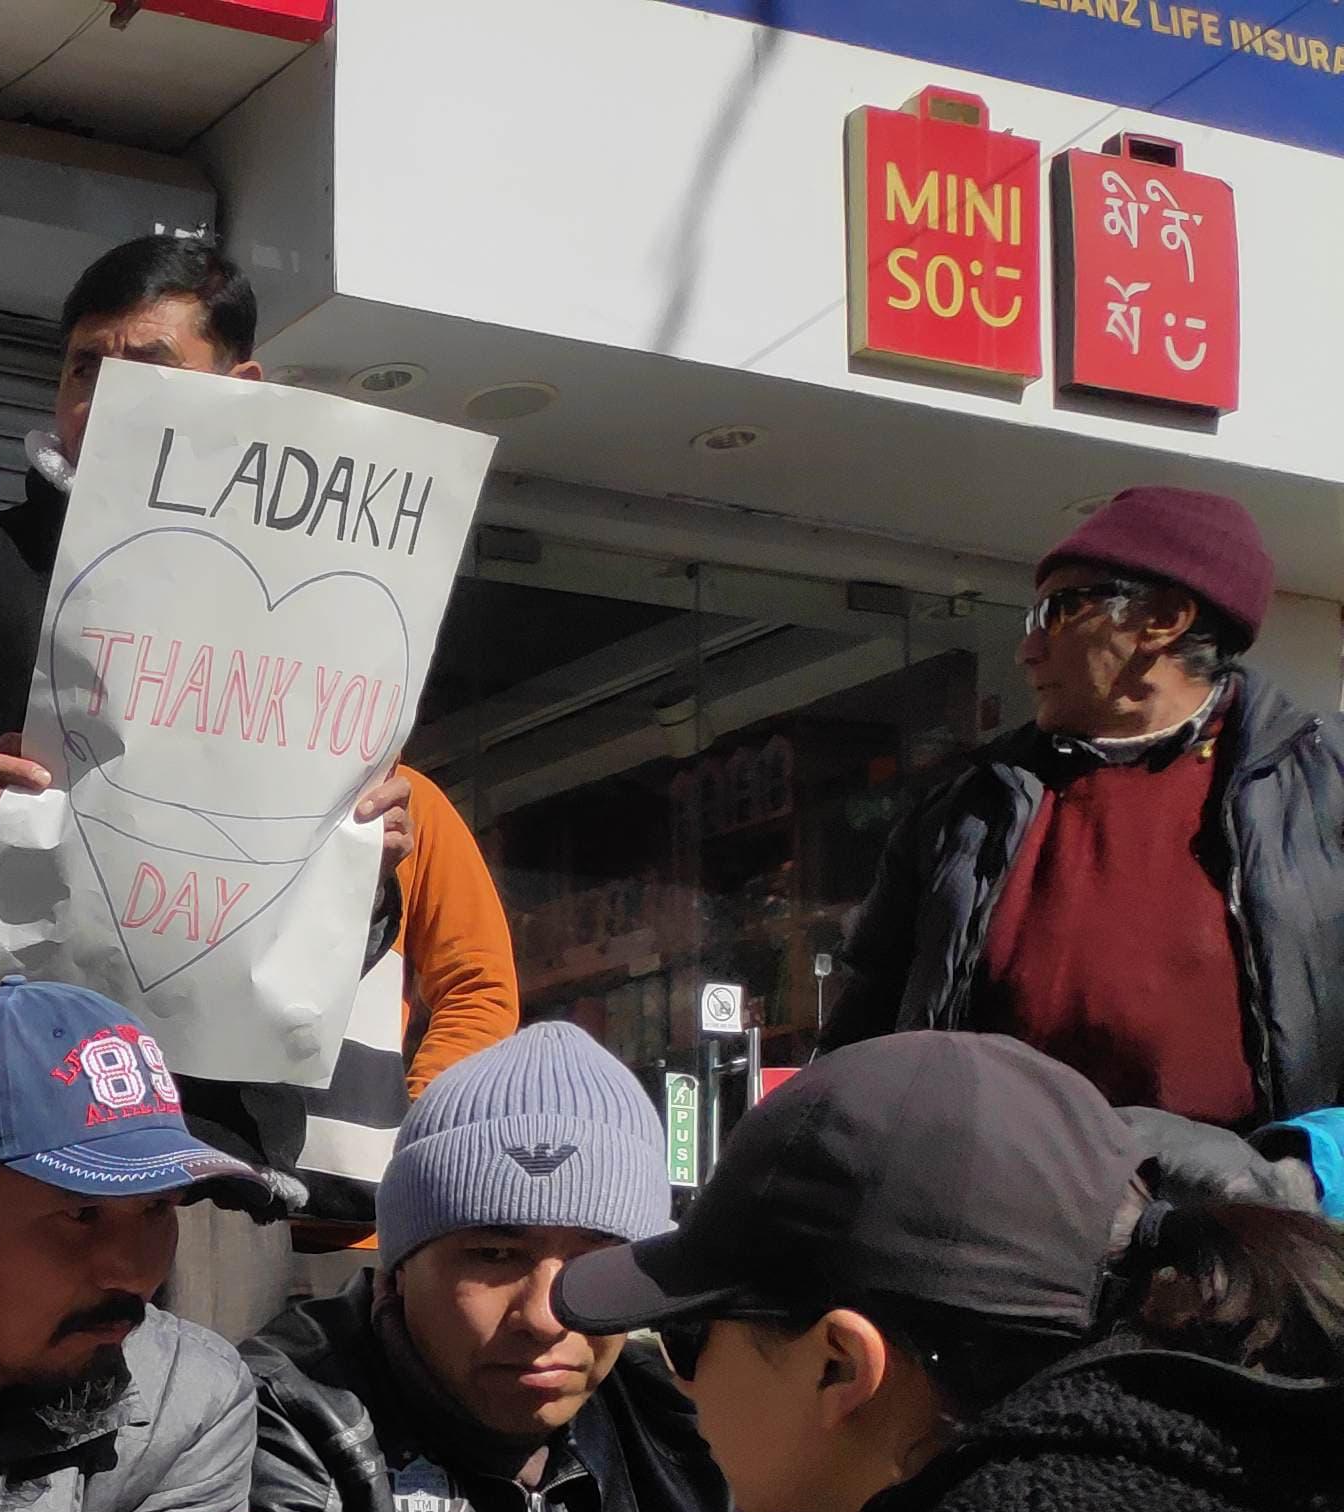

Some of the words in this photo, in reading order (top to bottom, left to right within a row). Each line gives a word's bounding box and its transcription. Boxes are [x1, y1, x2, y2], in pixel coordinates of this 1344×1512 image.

[1150, 0, 1223, 46] LIFE
[886, 161, 1021, 246] MINI
[147, 427, 433, 556] LADAKH
[78, 627, 303, 747] THANK
[306, 665, 401, 762] YOU
[120, 862, 250, 947] DAY
[675, 1110, 689, 1181] PUSH
